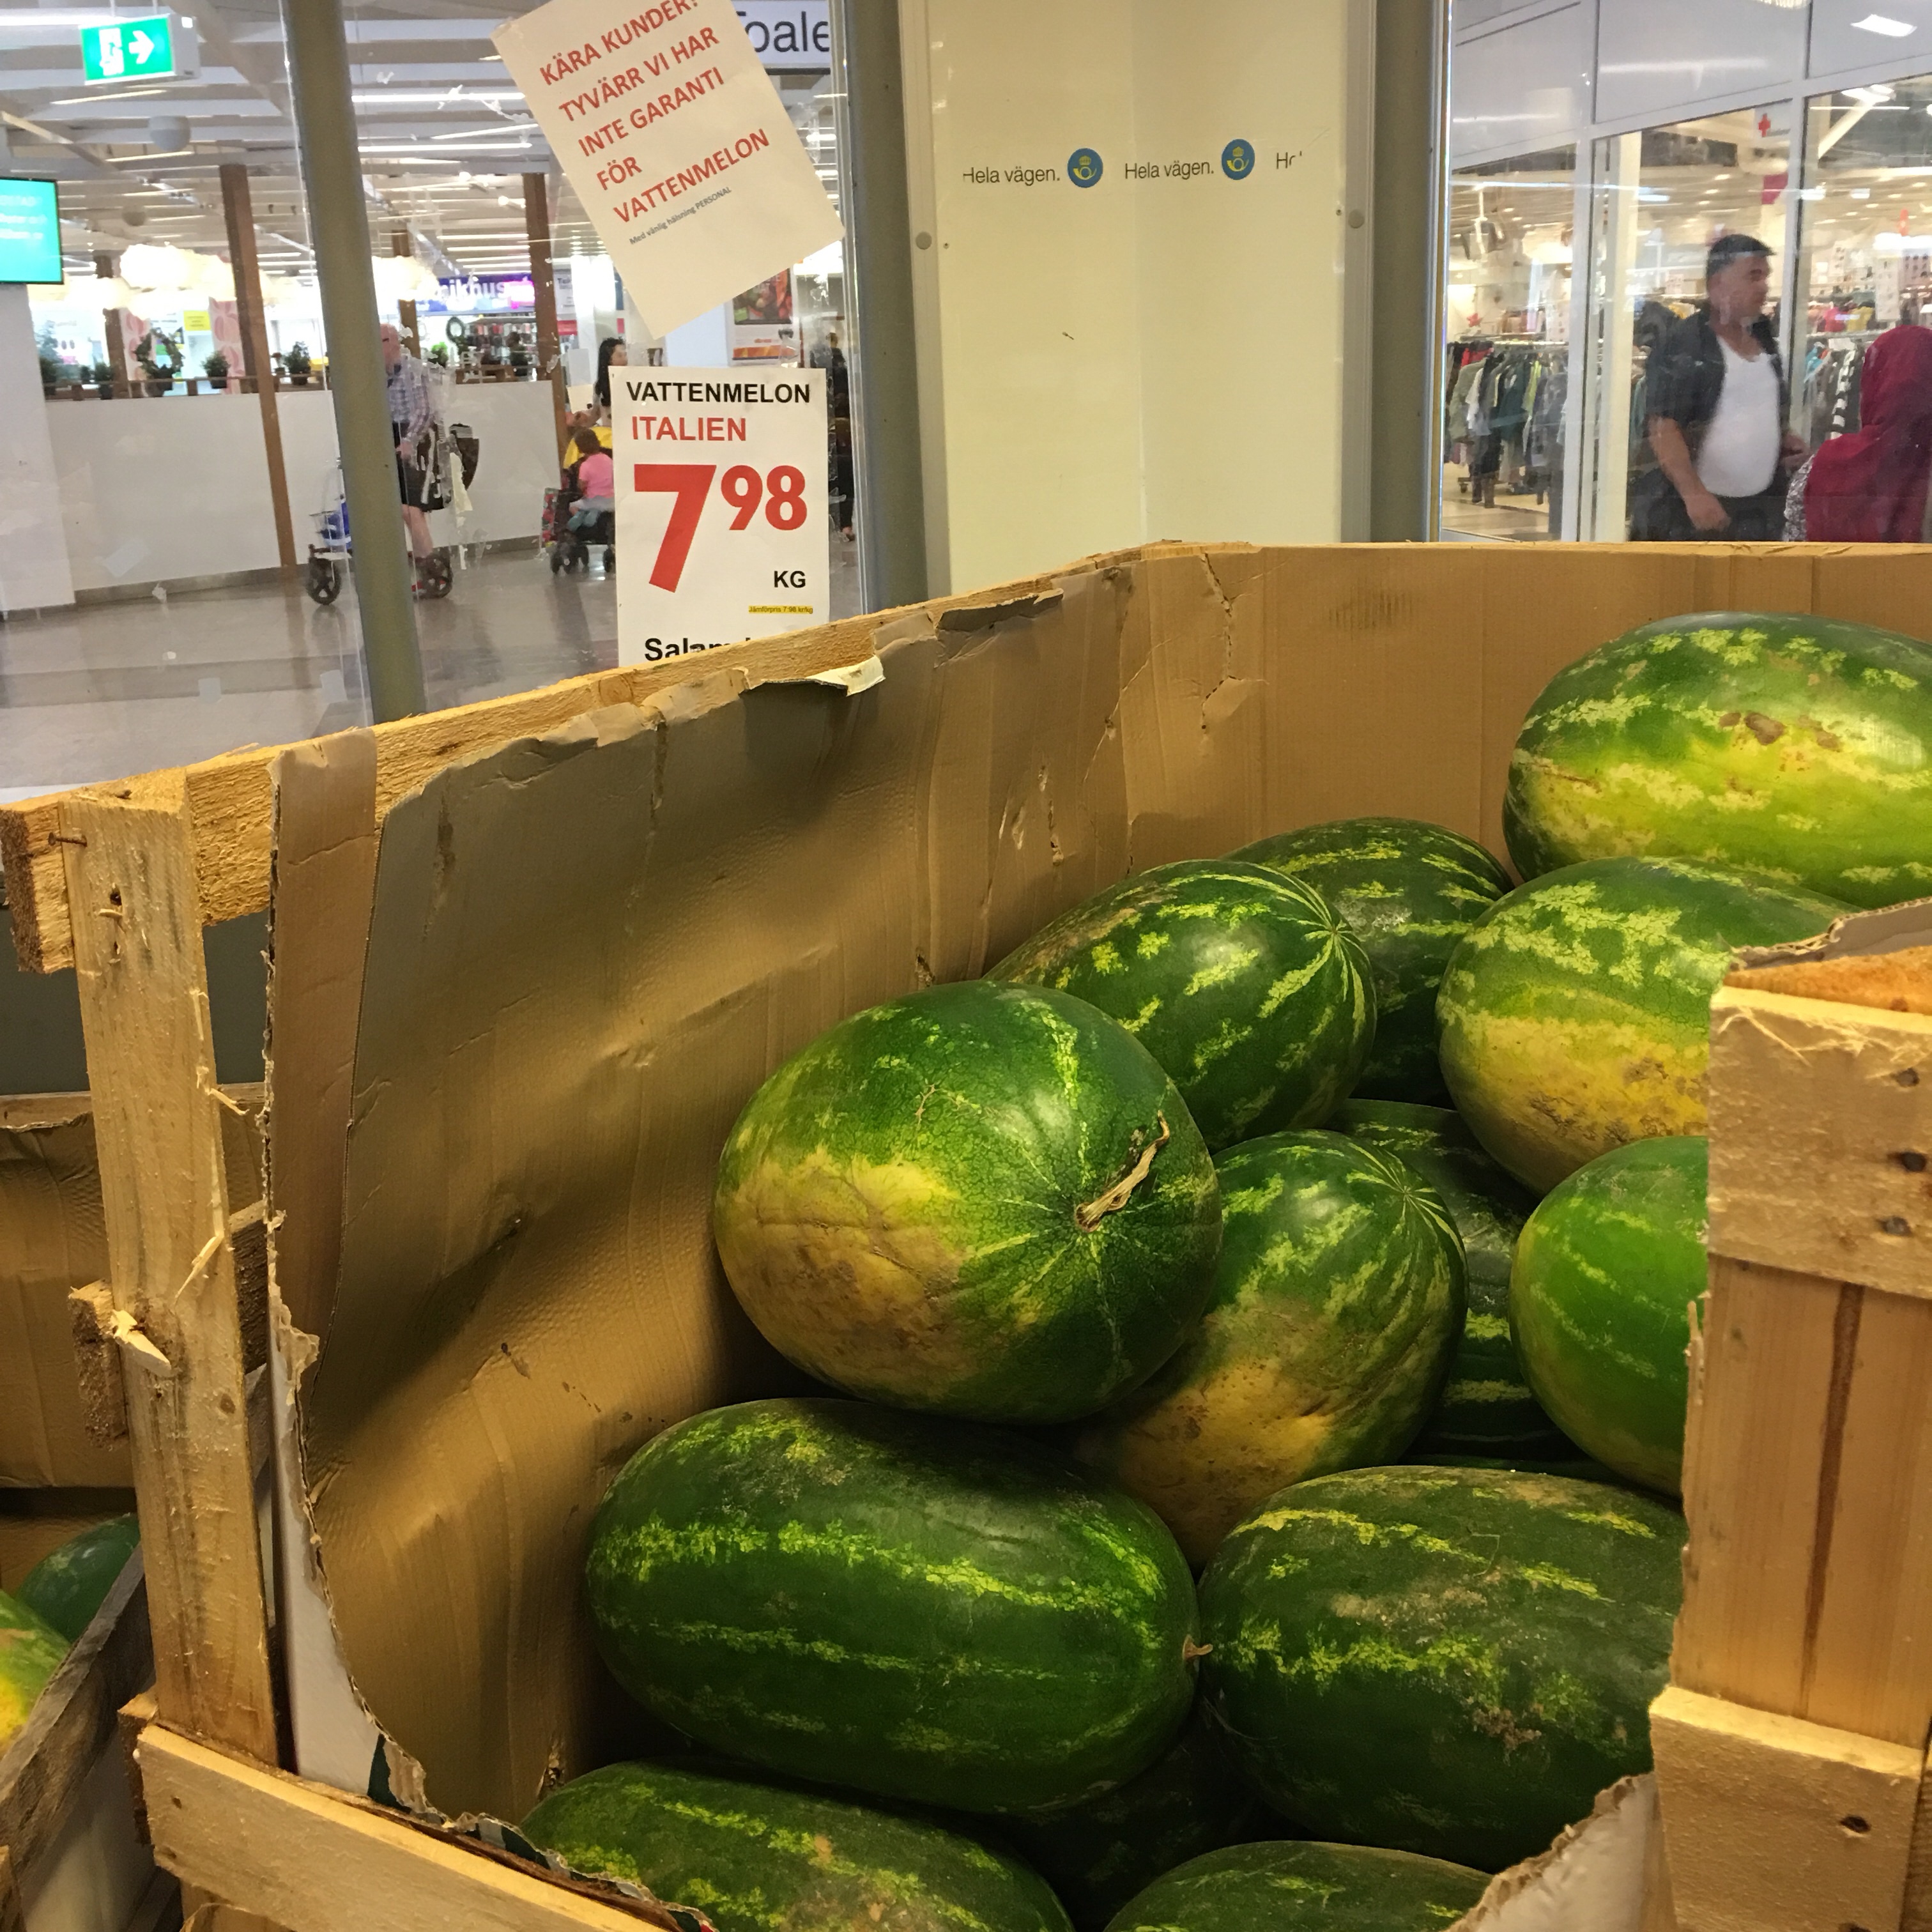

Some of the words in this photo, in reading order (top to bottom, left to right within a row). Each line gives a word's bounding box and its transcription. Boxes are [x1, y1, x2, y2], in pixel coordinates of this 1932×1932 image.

[540, 43, 602, 86] KÄRA
[558, 67, 645, 121] TYVÄRR
[643, 52, 670, 76] VI
[670, 27, 719, 64] HAR
[578, 118, 629, 157] INTE
[629, 66, 724, 128] GARANTI
[596, 157, 643, 190] FÖR
[613, 128, 769, 223] VATTENMELON
[963, 166, 1000, 183] Hela
[1004, 165, 1061, 187] vägen.
[1125, 162, 1160, 180] Hela
[1163, 160, 1215, 180] vägen.
[629, 231, 646, 245] Med
[646, 222, 668, 236] vänlig
[666, 206, 696, 225] hälsning
[694, 187, 732, 210] PERSONAL
[626, 381, 811, 404] VATTENMELON
[632, 416, 747, 441] ITALIEN
[774, 571, 807, 588] KG
[645, 638, 731, 662] Sal
